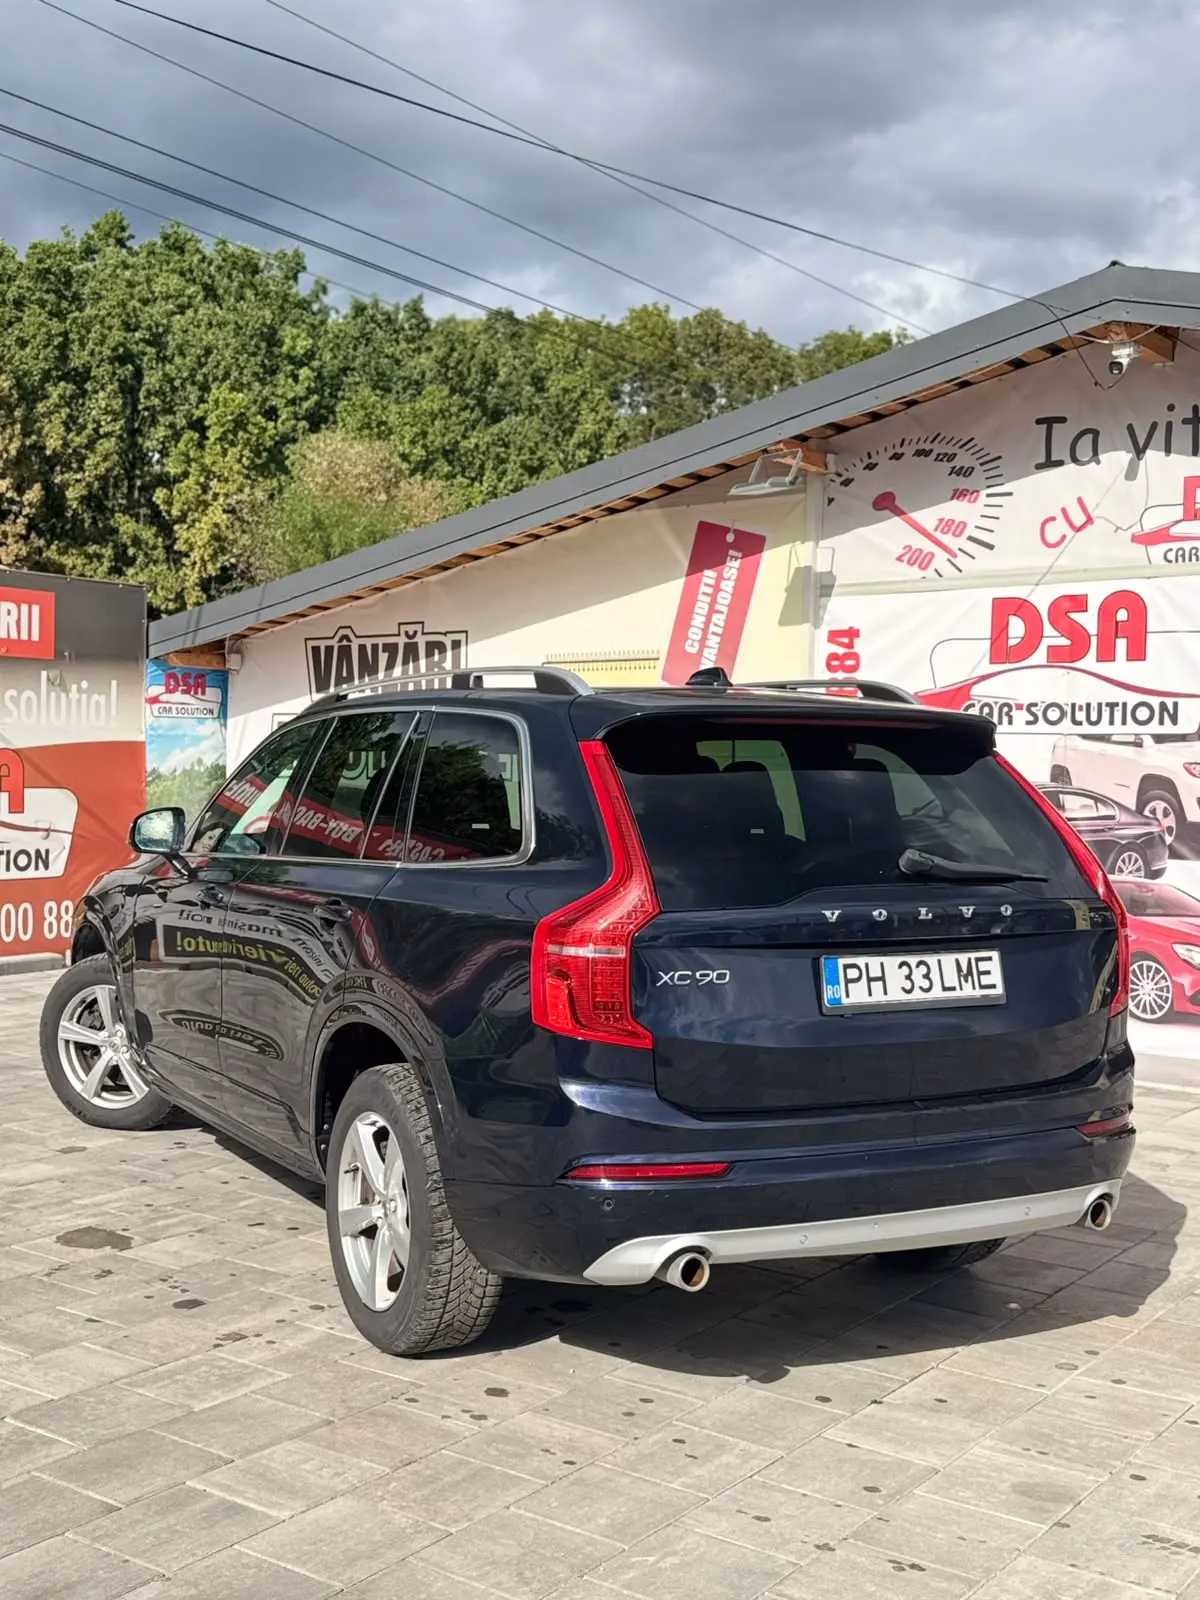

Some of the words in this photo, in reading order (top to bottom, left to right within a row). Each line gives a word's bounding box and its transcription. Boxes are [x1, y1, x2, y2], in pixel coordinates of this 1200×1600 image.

[1035, 416, 1101, 470] Ia
[1126, 403, 1200, 461] vit
[933, 452, 957, 463] 120
[947, 465, 975, 478] 140
[950, 487, 980, 504] 160
[933, 517, 968, 538] 180
[1040, 496, 1094, 548] cu
[895, 544, 935, 571] 200
[989, 589, 1148, 665] DSA
[165, 672, 206, 696] DSA
[175, 706, 215, 717] SOLUTION
[1025, 700, 1179, 727] SOLUTION
[821, 904, 1013, 923] VOLVO
[842, 961, 888, 999] PH
[897, 960, 934, 995] 33
[937, 956, 997, 993] LME
[827, 984, 840, 999] RO
